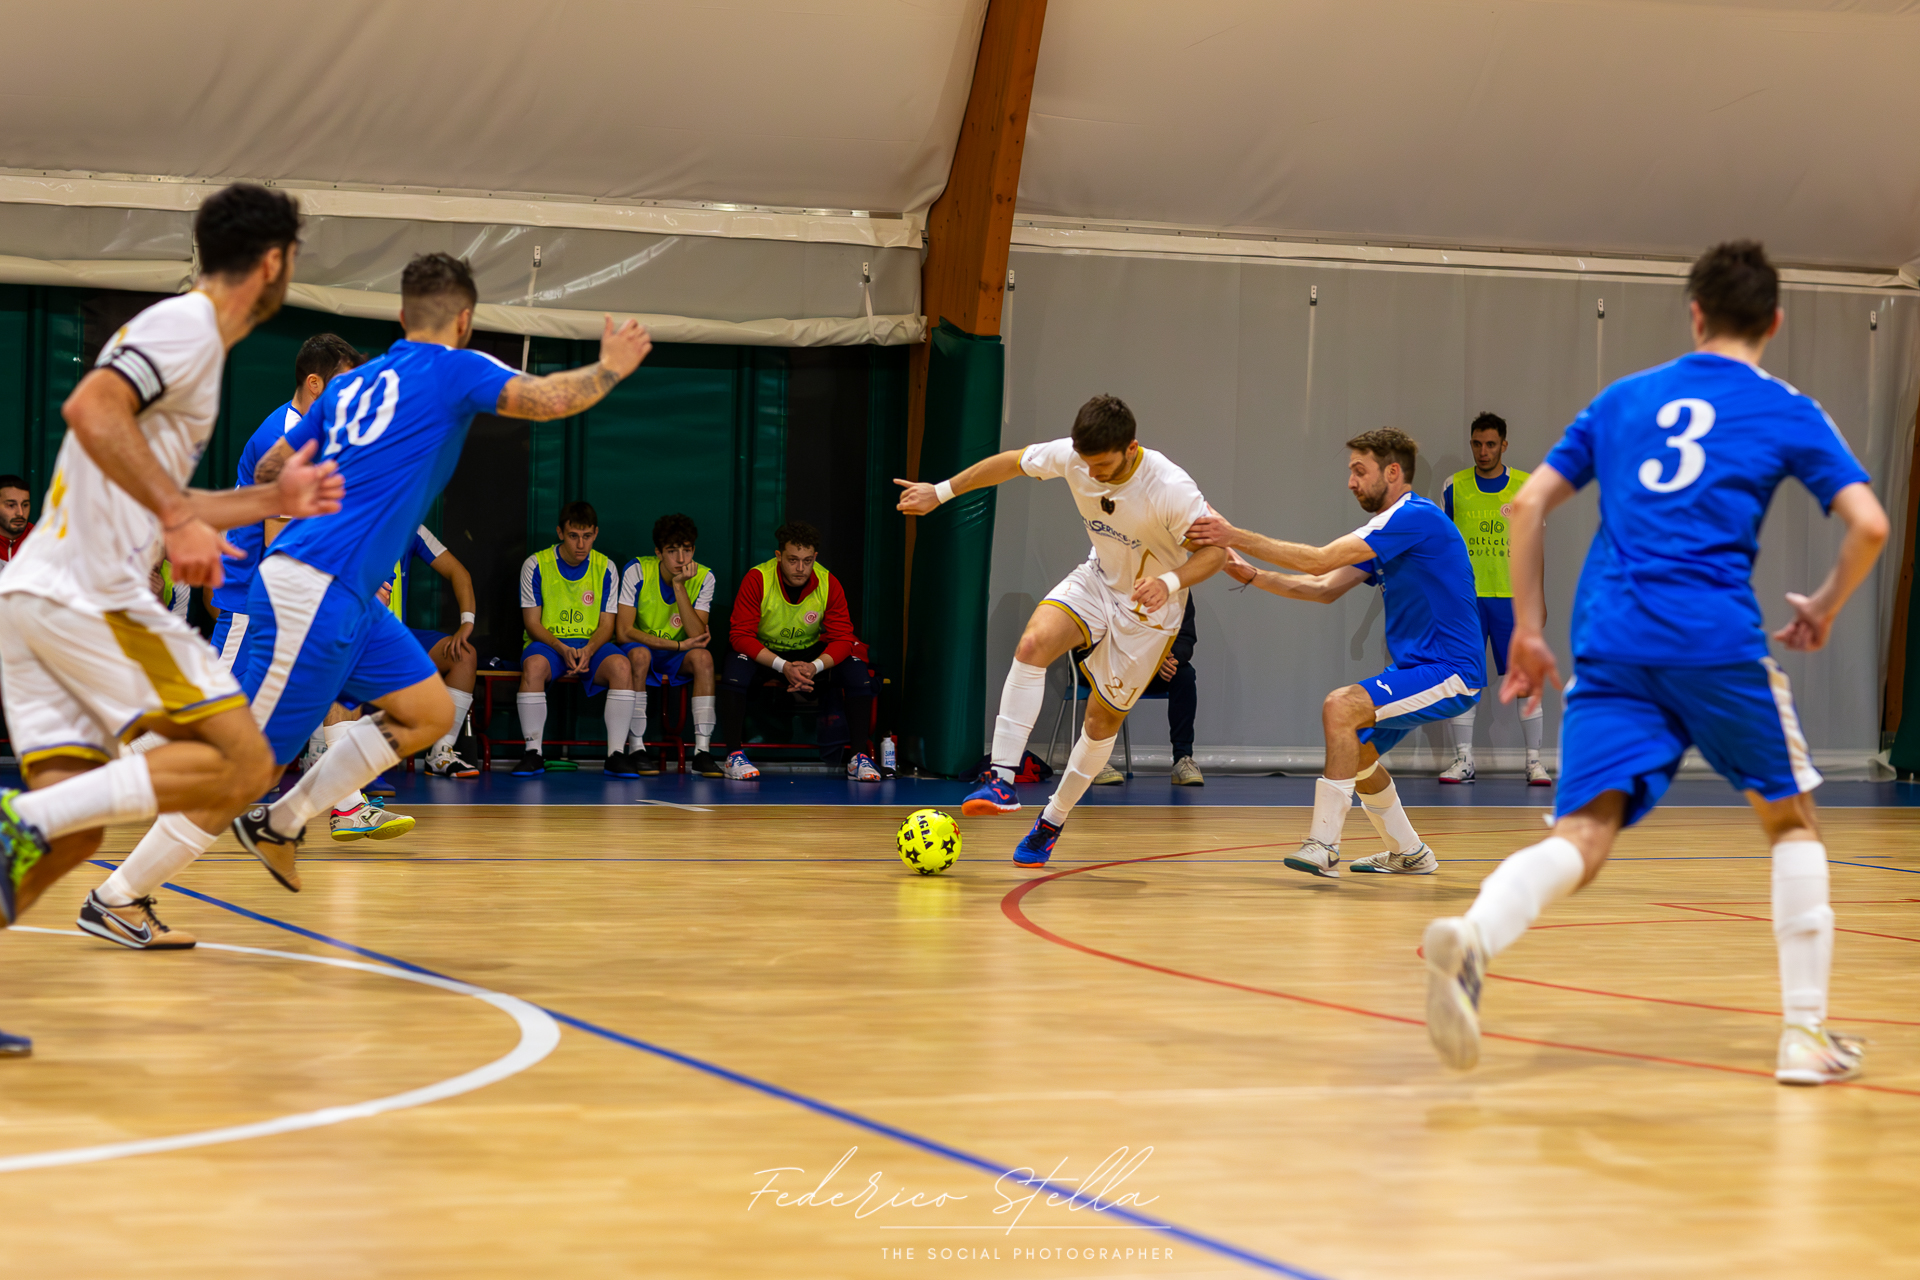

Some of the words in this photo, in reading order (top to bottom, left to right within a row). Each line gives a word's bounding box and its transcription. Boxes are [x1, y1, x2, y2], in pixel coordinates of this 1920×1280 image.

[324, 368, 400, 456] 10
[1638, 398, 1717, 493] 3
[1104, 676, 1139, 706] 21
